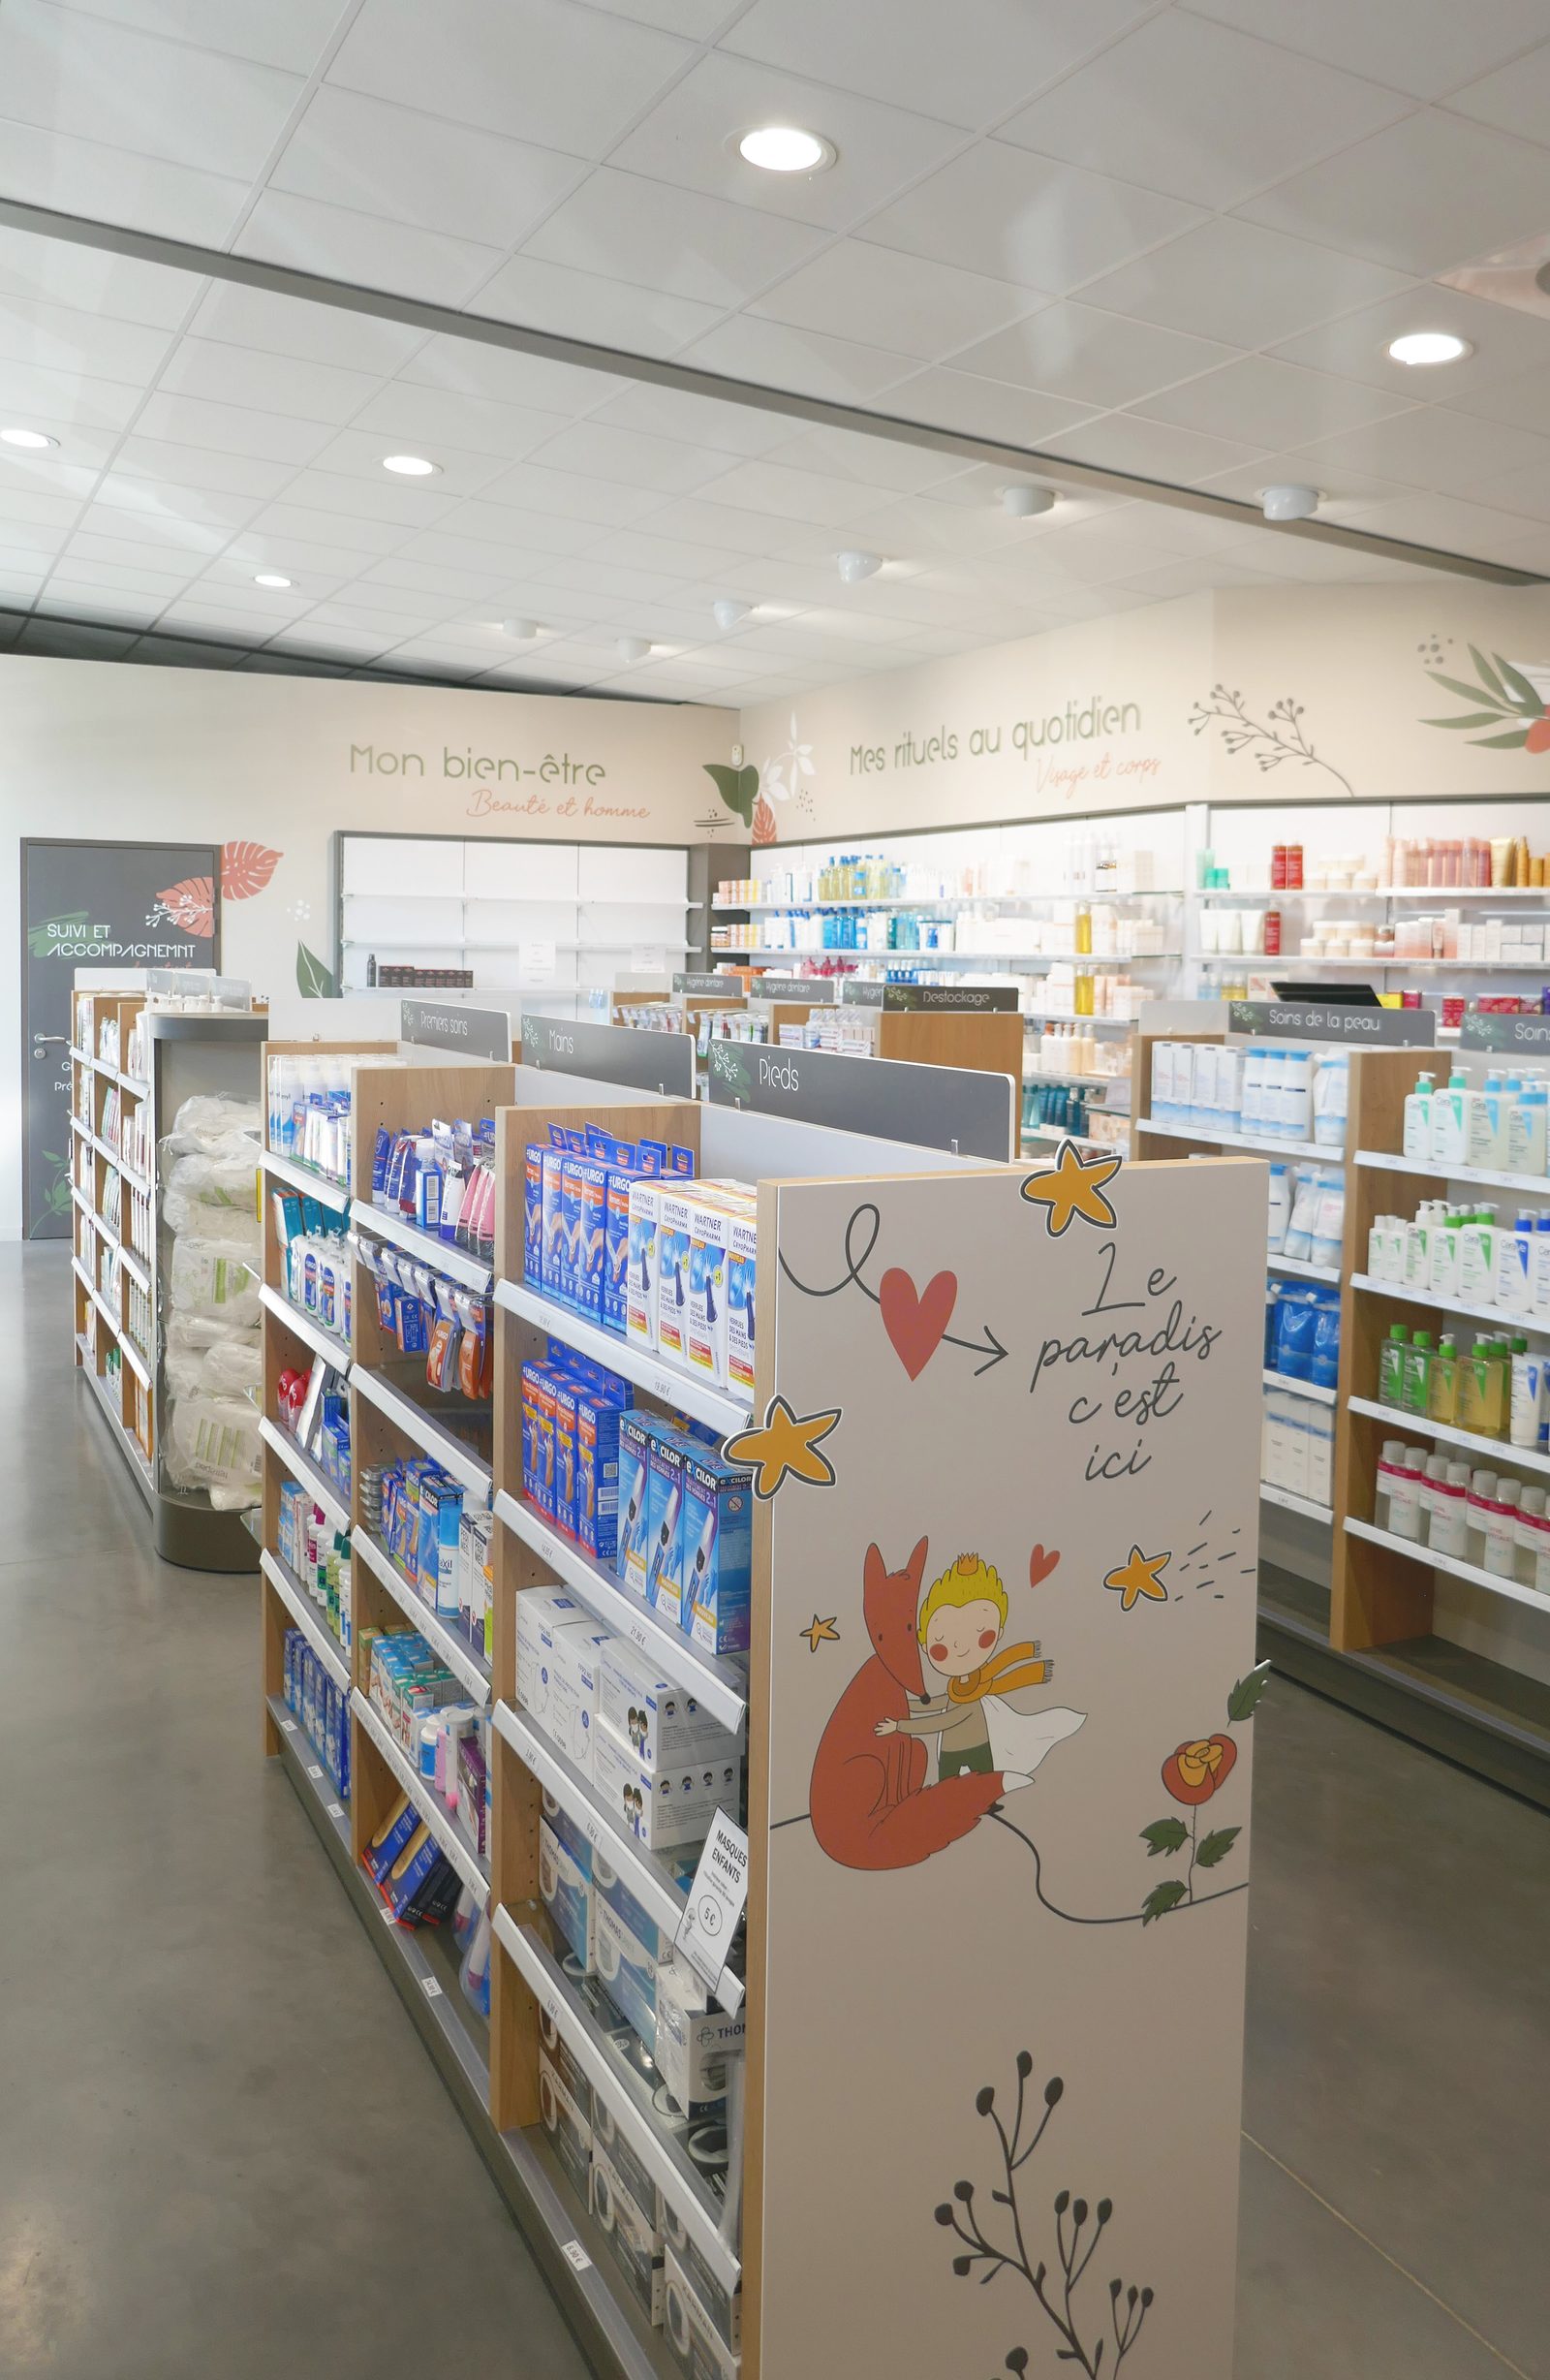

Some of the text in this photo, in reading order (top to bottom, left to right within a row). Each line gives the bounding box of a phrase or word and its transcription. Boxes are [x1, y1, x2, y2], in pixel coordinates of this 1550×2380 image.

[850, 696, 1142, 775] Mes rituels au quotidien
[350, 743, 606, 786] Mon bien-être
[1036, 752, 1161, 799] Visage et corps
[466, 789, 651, 819] Beauté et homme
[47, 924, 111, 939] SUIVI ET
[46, 943, 196, 958] ACCOMPAGNEMNT
[922, 990, 990, 1006] Destockage
[420, 1011, 468, 1036] Premiers soins
[1269, 1009, 1380, 1032] Soins de la peau
[548, 1027, 574, 1054] Mains
[1514, 1023, 1550, 1042] Soin
[760, 1057, 799, 1092] Pieds
[528, 1149, 541, 1163] URGO
[547, 1154, 561, 1171] URGO
[567, 1161, 582, 1178] URGO
[587, 1169, 604, 1184] URGO
[612, 1174, 631, 1192] URGO
[664, 1201, 688, 1219] WARTNER
[694, 1212, 722, 1232] WARTNER
[733, 1225, 757, 1244] WARTNE
[733, 1239, 756, 1255] CRYOPHAR
[1081, 1241, 1178, 1317] Le
[1029, 1300, 1223, 1394] paradis
[525, 1367, 540, 1384] URGO
[542, 1378, 557, 1396] URGO
[1069, 1361, 1185, 1425] c'est
[560, 1393, 575, 1411] URGO
[581, 1404, 596, 1425] URGO
[650, 1438, 681, 1468] eXCILOR
[1085, 1439, 1153, 1482] ici
[686, 1459, 717, 1491] eXCILOR
[716, 1830, 748, 1867] MASQUES
[712, 1848, 741, 1884] ENFANTS
[704, 1907, 716, 1926] 5 €
[717, 2023, 745, 2040] THO
